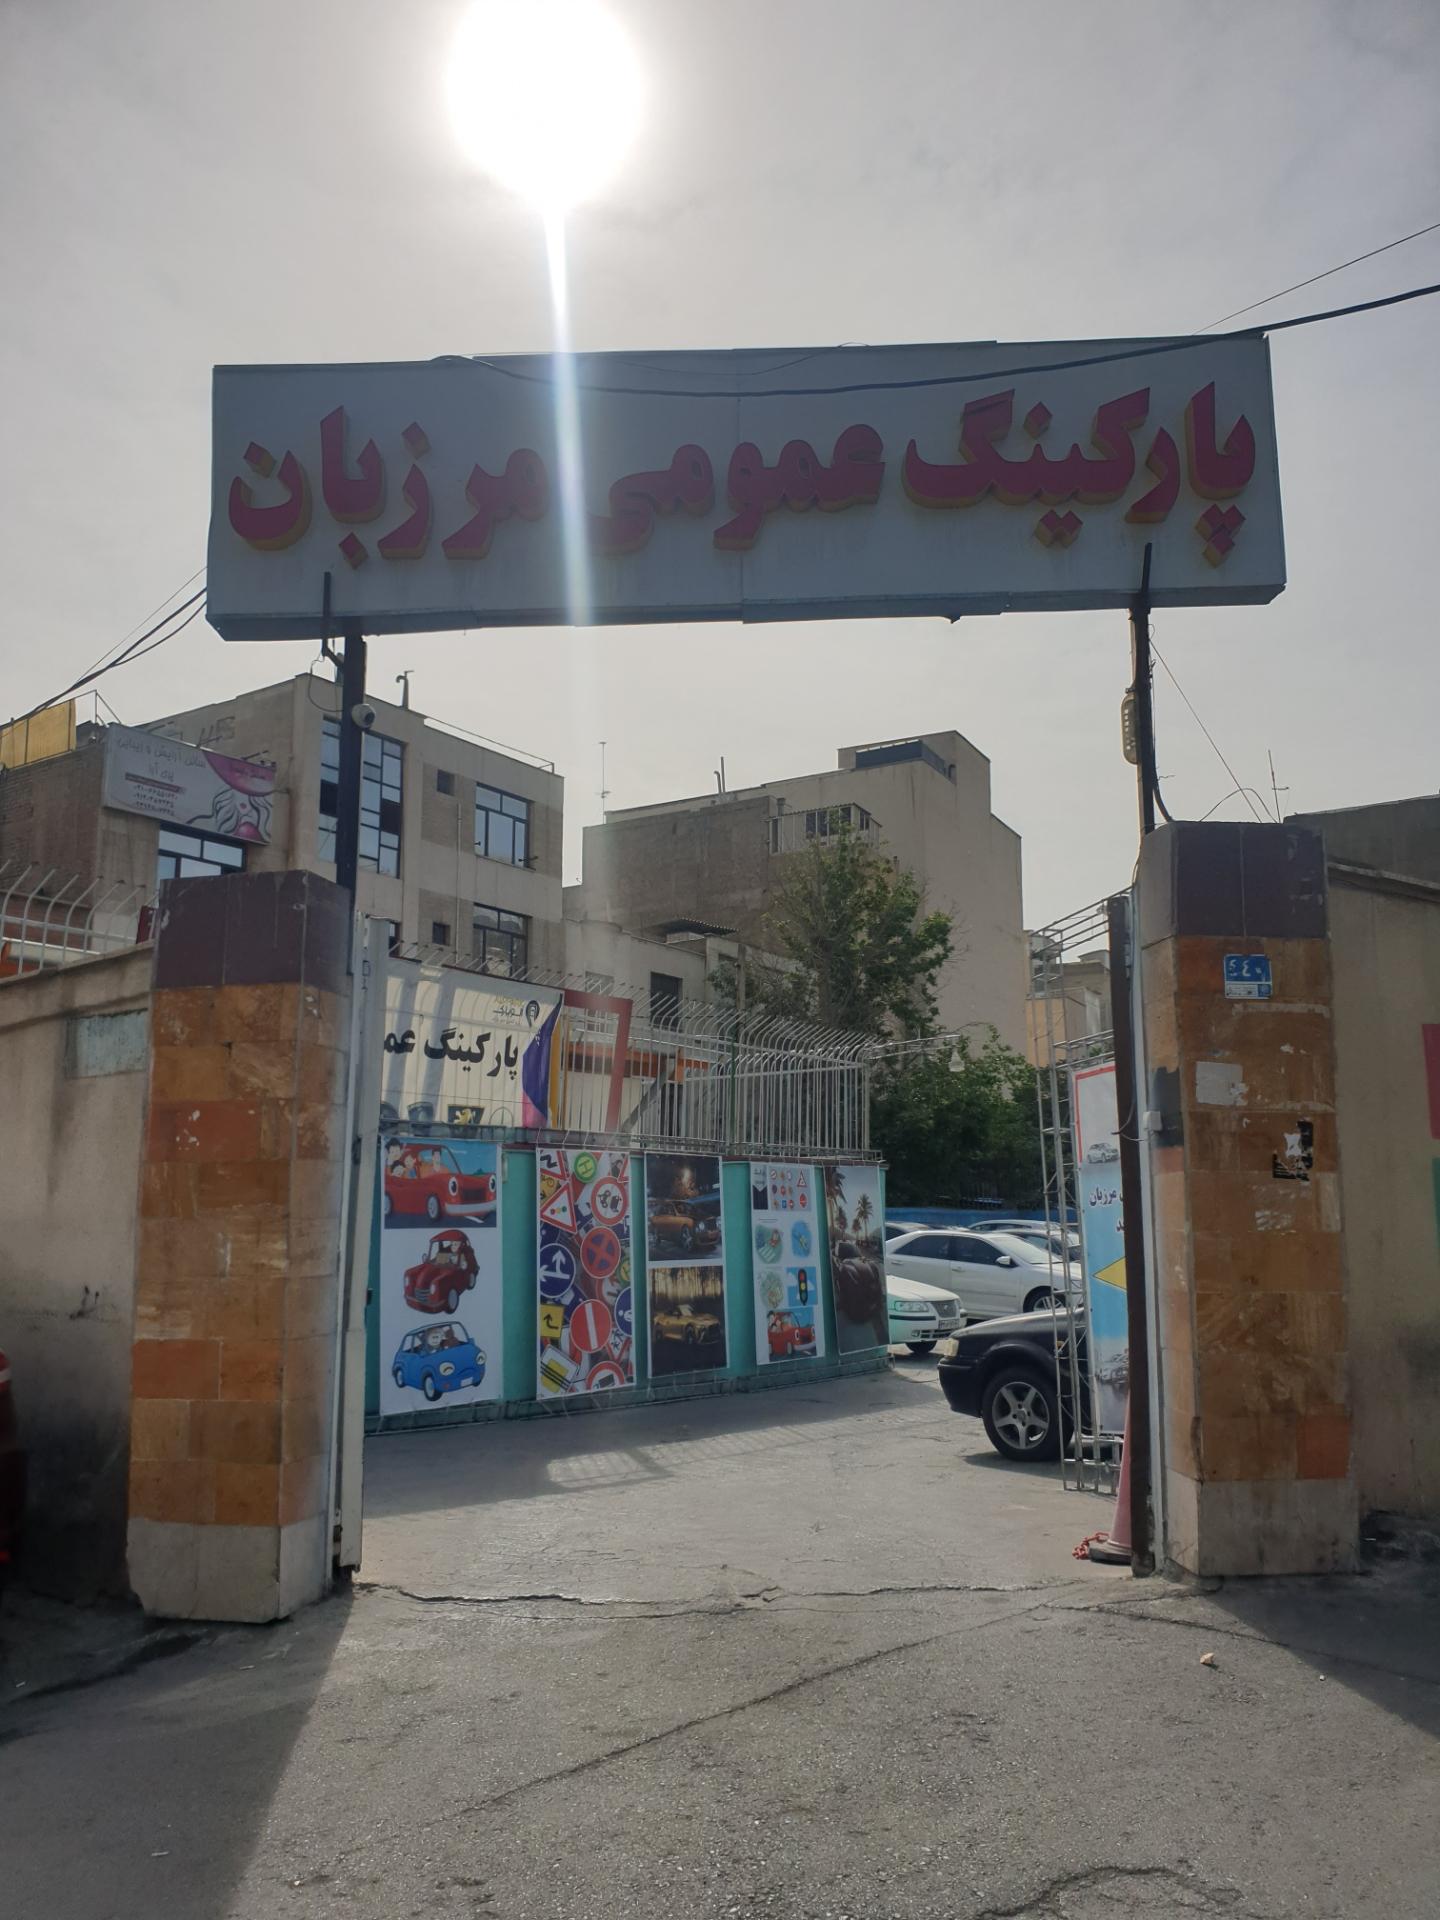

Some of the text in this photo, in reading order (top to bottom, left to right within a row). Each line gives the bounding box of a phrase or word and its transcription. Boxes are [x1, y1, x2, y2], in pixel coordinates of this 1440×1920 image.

[228, 381, 1255, 570] پارکینگ عمومی مرزبان
[384, 1027, 519, 1081] پارکینگ عم
